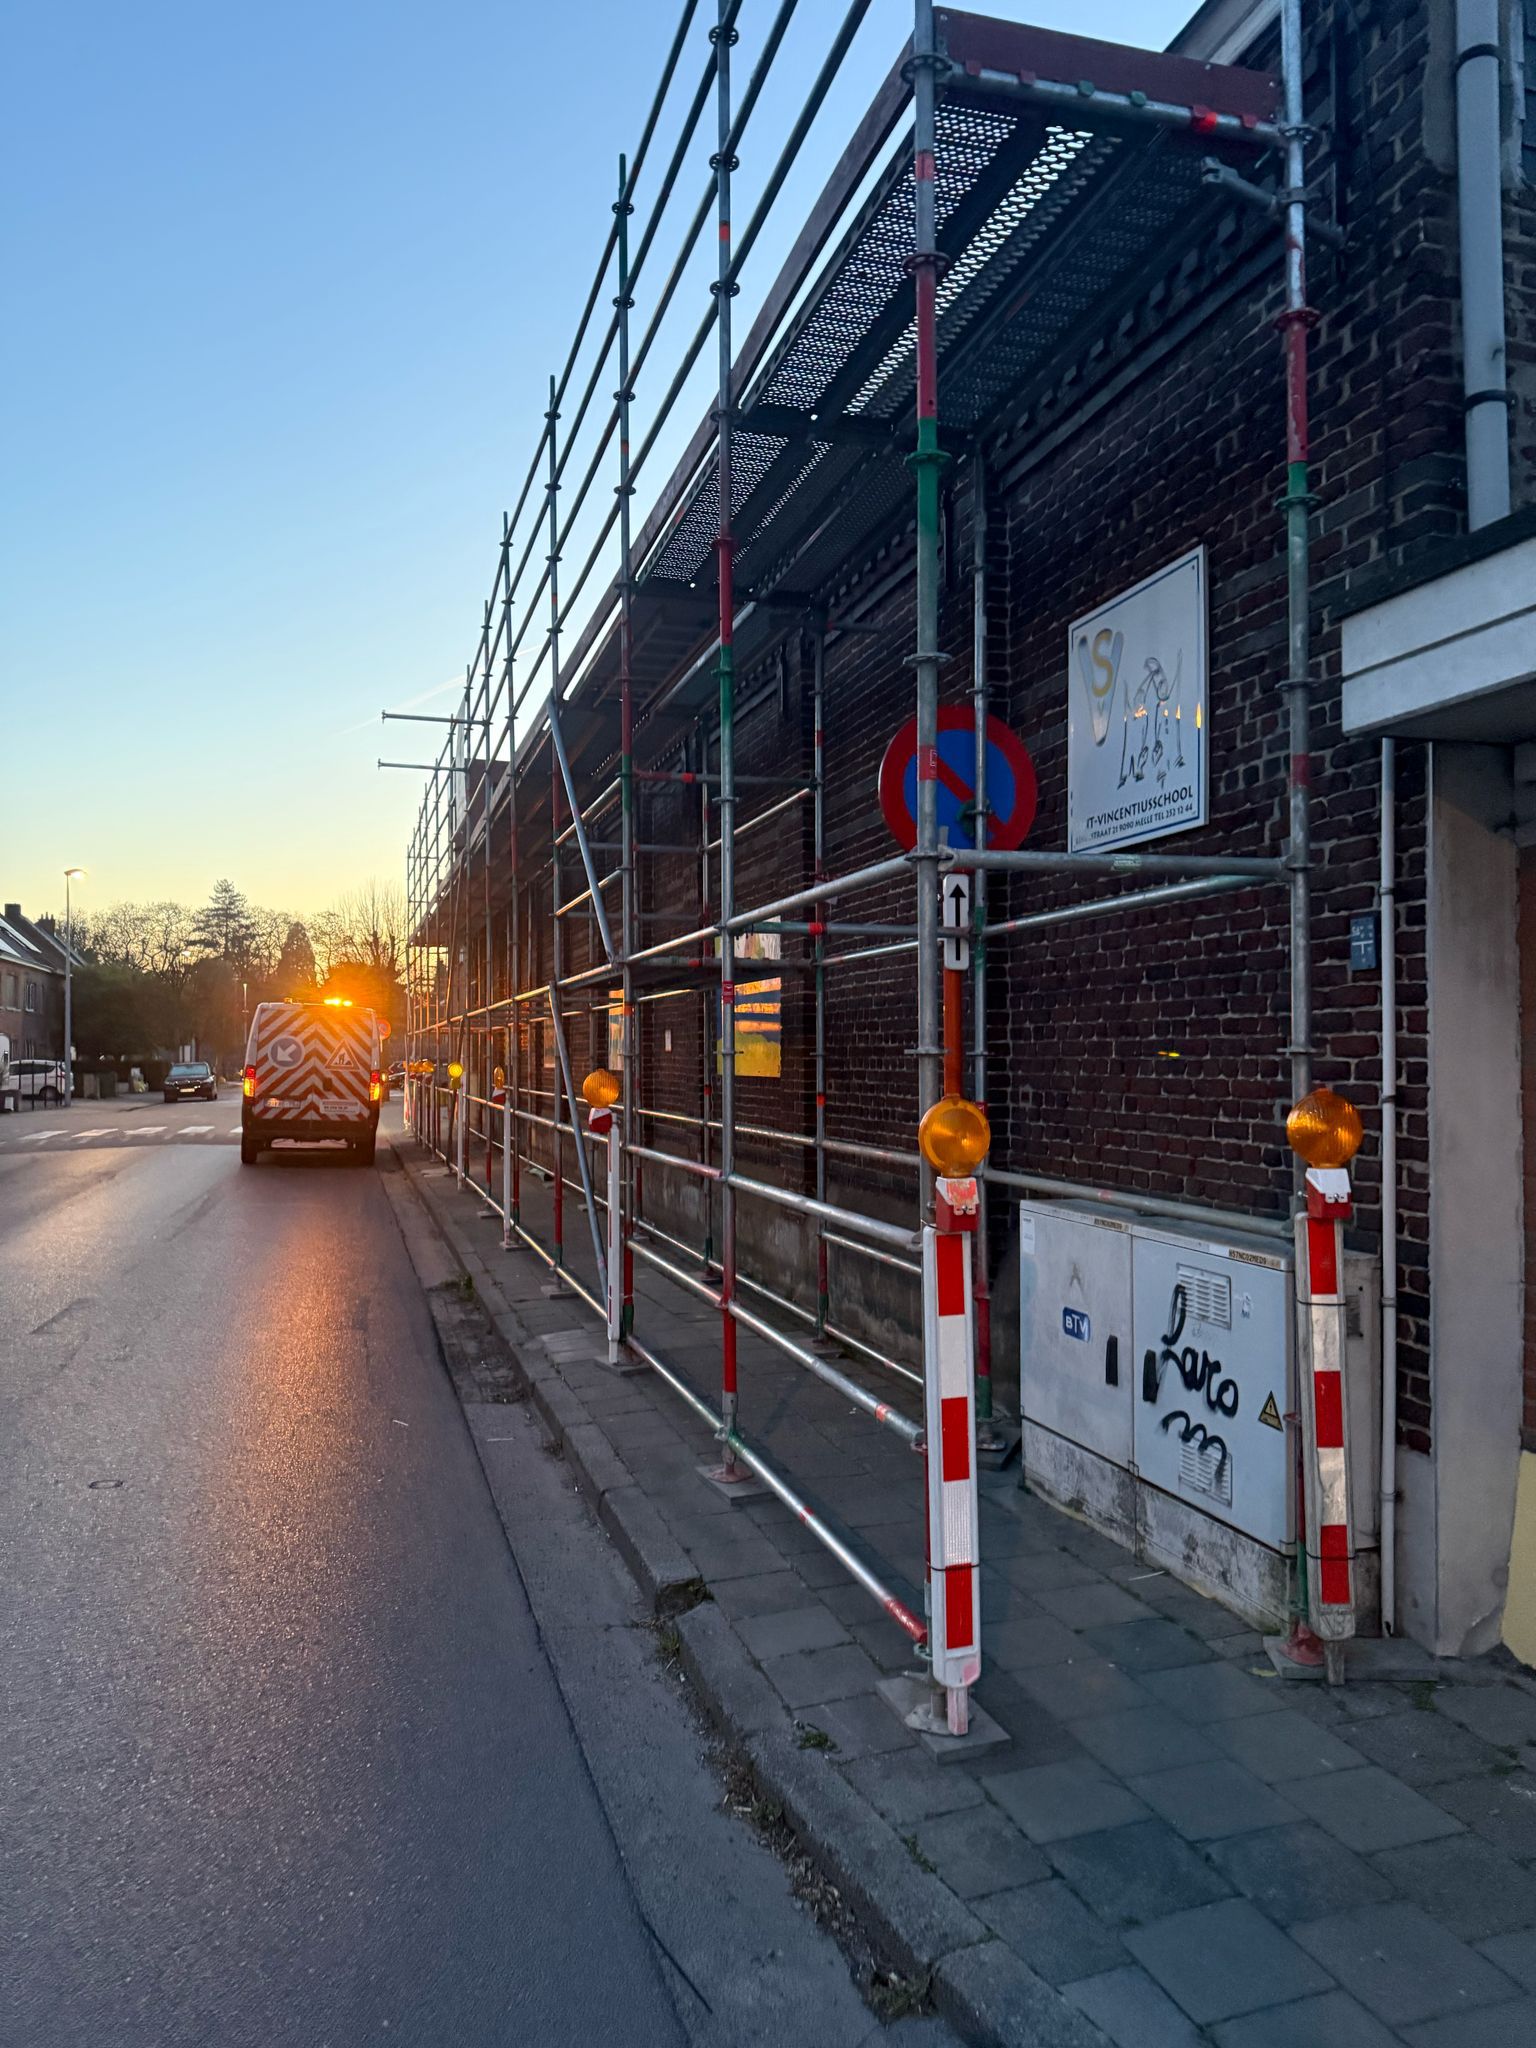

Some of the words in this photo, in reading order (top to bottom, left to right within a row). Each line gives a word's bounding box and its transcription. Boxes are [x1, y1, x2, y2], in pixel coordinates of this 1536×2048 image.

[1135, 815, 1153, 827] MELLE
[1154, 812, 1164, 822] TEL
[1185, 803, 1193, 811] 44
